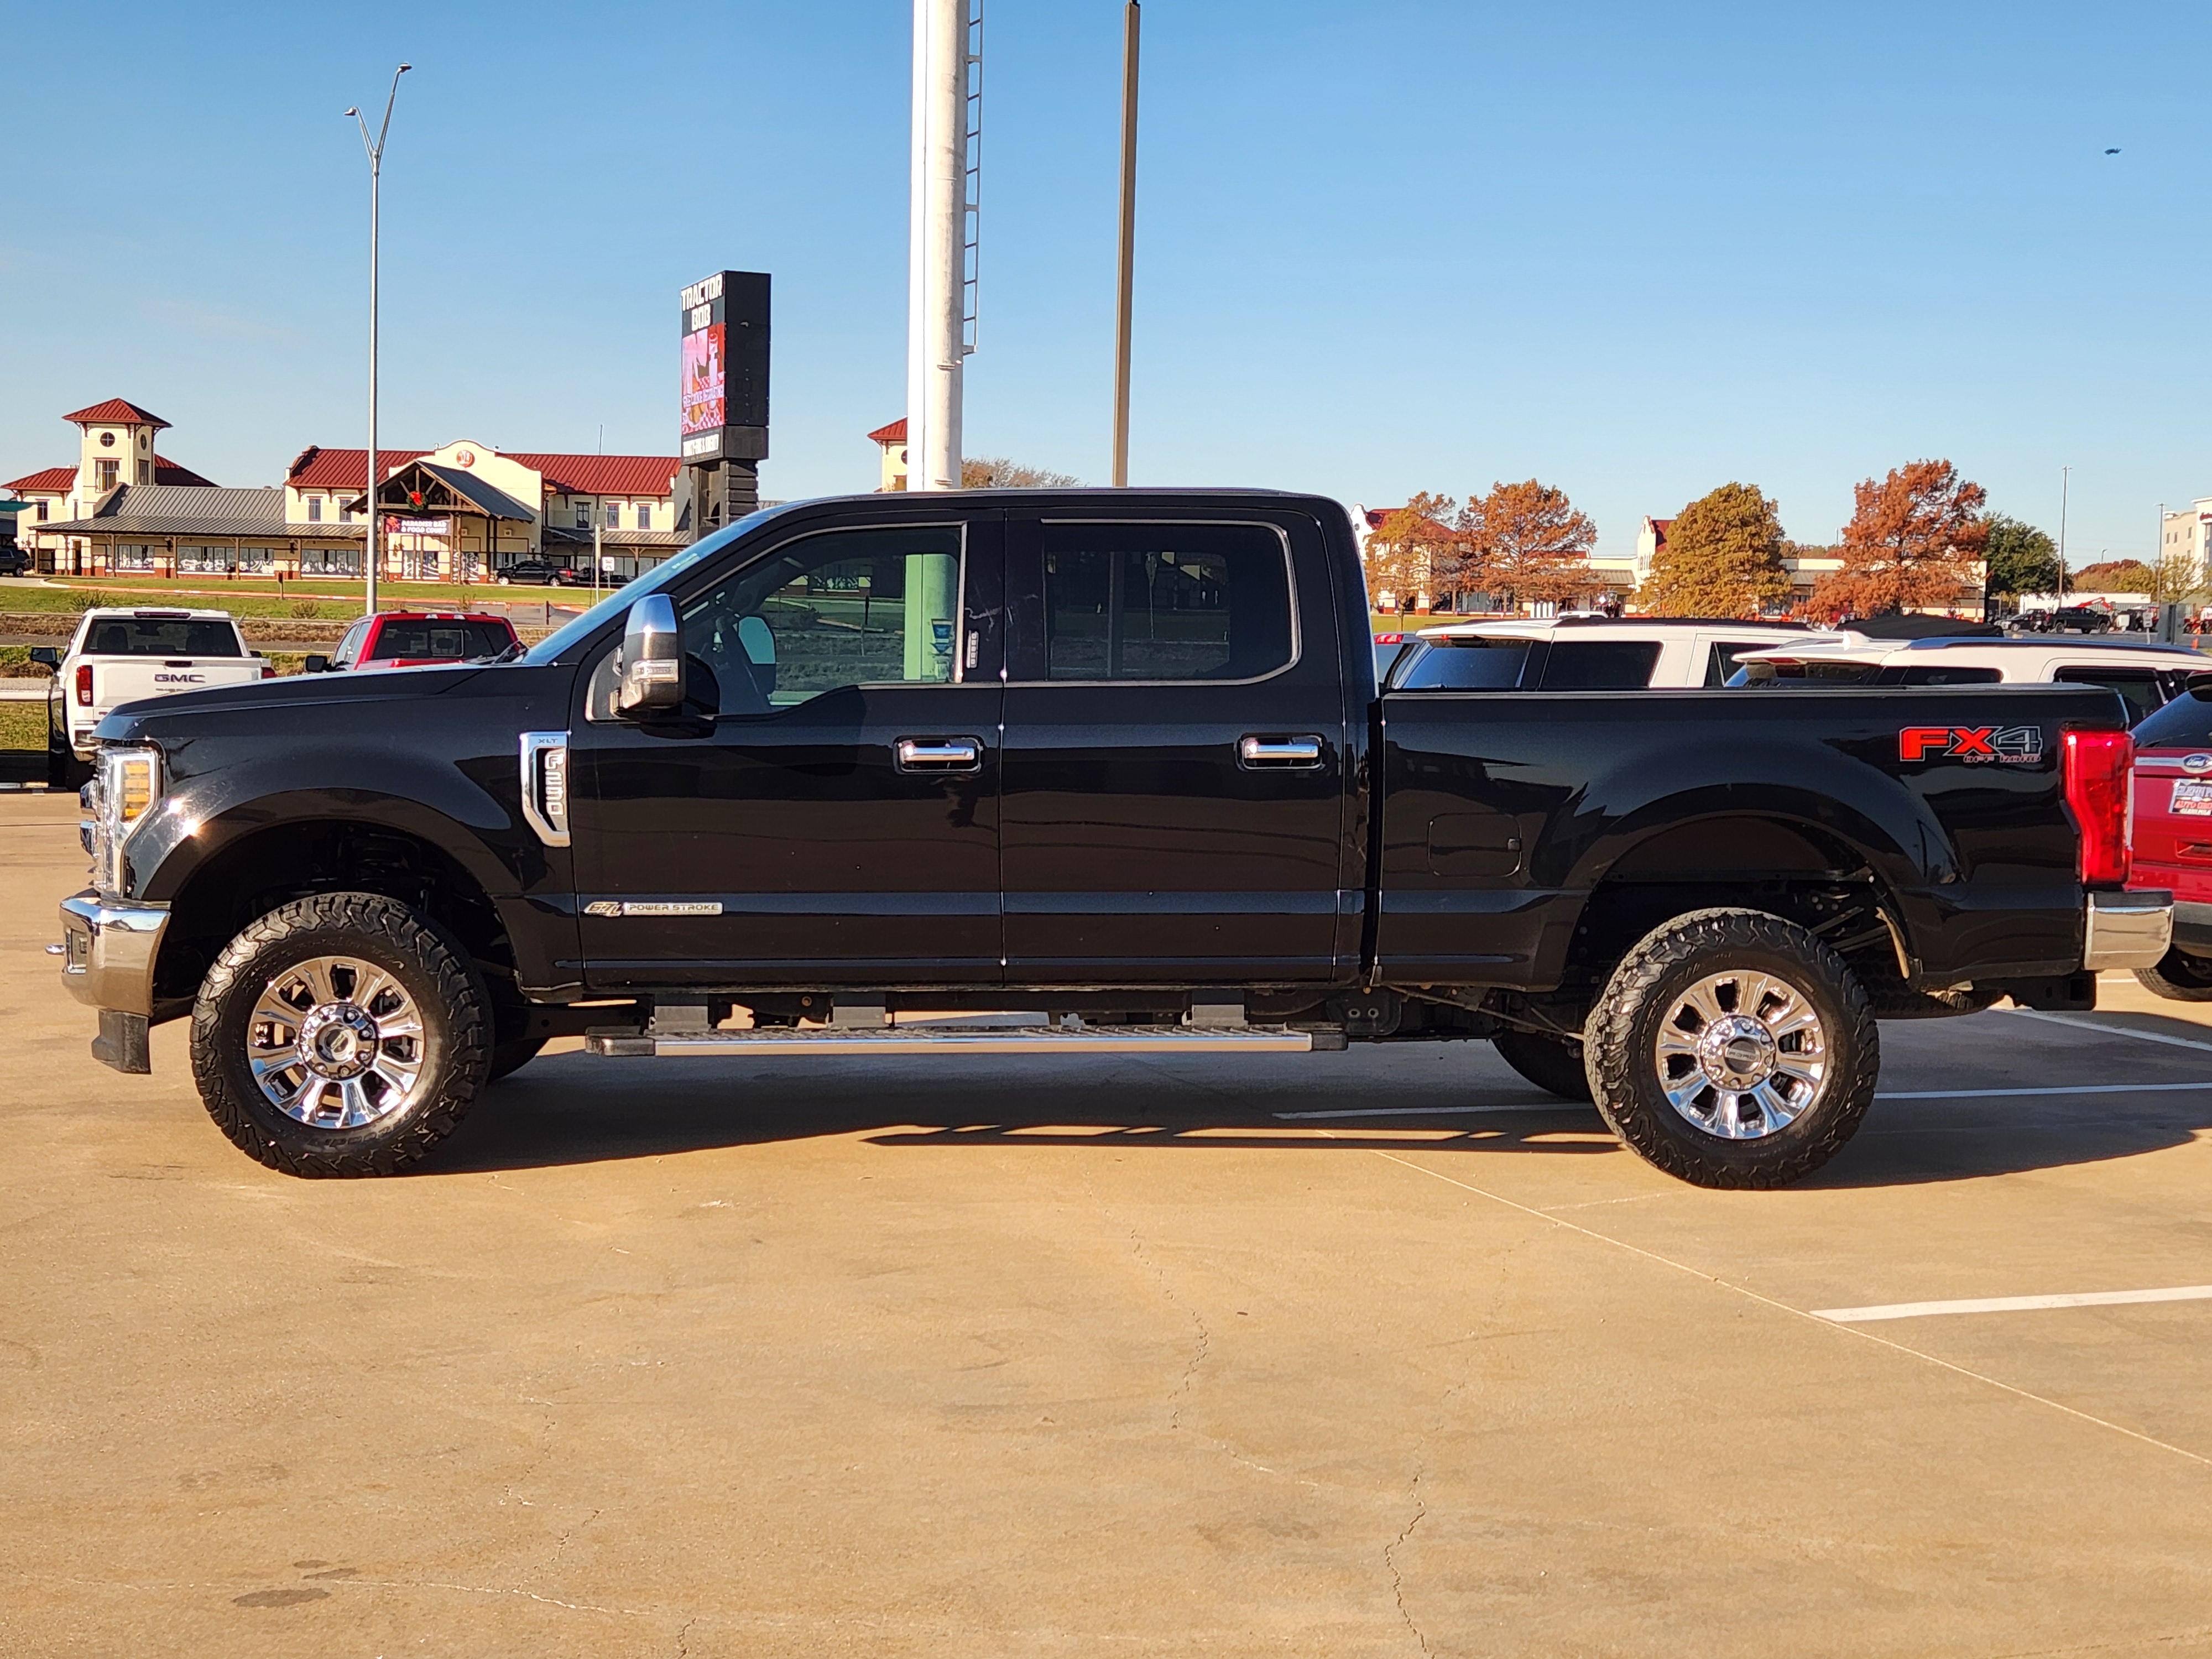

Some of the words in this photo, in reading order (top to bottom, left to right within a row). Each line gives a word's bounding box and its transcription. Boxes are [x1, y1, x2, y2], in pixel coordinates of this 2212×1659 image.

[681, 273, 722, 311] TRACTOR
[692, 304, 711, 331] BOB
[155, 674, 206, 683] GMC
[1900, 726, 2043, 761] FX4
[2000, 755, 2042, 763] ROAD
[2174, 800, 2197, 808] AUTO
[1729, 1051, 1757, 1060] FORD
